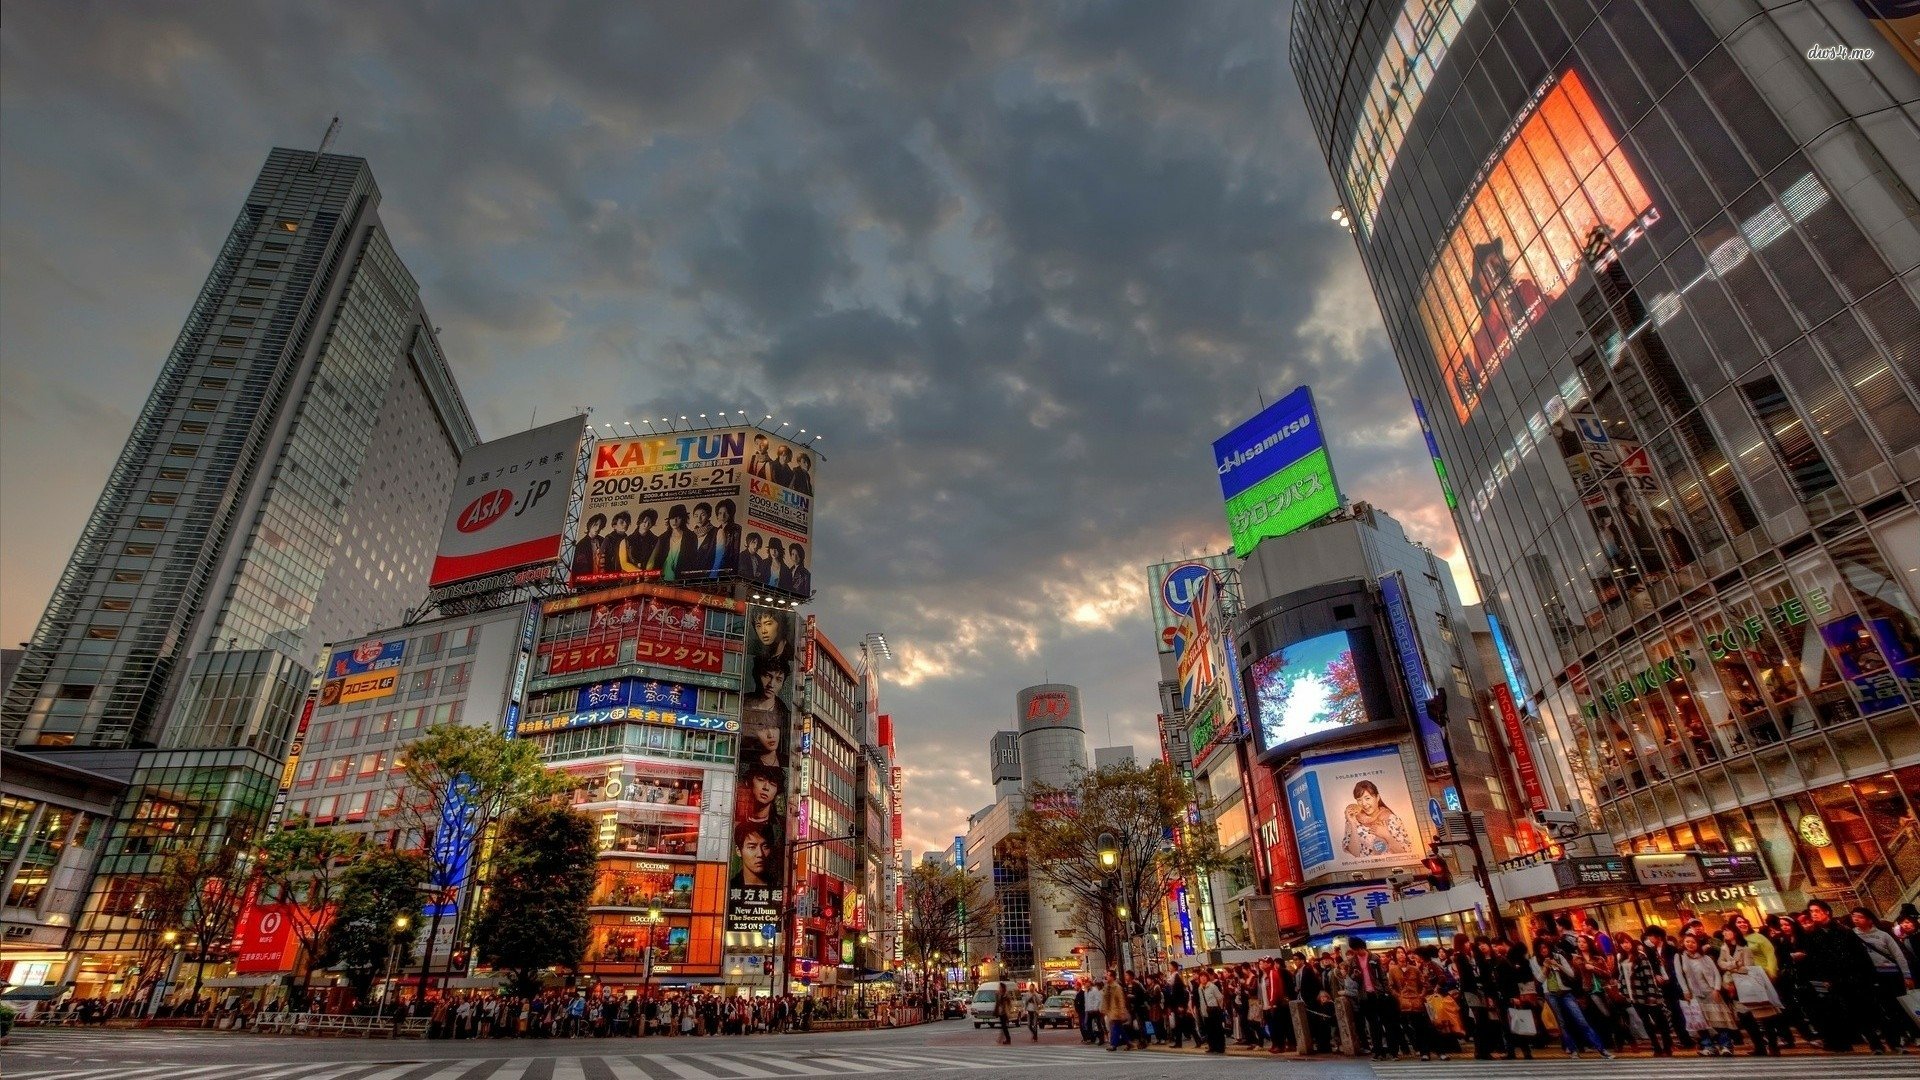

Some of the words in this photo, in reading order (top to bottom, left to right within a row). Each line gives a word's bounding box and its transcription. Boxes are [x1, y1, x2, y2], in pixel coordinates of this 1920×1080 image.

[595, 432, 746, 470] KAT-TUN
[1218, 413, 1311, 475] Hisamitsu
[467, 452, 564, 486] 最速ブログ検索
[591, 472, 692, 496] 2009.5.15
[750, 478, 809, 510] KAT-TUN
[749, 495, 789, 514] 2009.5.15
[1233, 472, 1324, 533] サロンパス
[516, 565, 551, 585] group
[553, 644, 617, 669] プライス
[637, 641, 719, 666] コンタクト
[343, 679, 379, 696] プロミス
[381, 678, 393, 687] 4F
[518, 714, 569, 733] 英会話&留学
[569, 711, 610, 724] イーオン
[611, 710, 623, 719] 6F
[628, 707, 677, 724] 英会話
[677, 715, 724, 729] イーオン
[726, 721, 738, 730] 6F
[636, 862, 669, 870] L'OCCITANE
[730, 888, 783, 902] 東方神起
[735, 907, 751, 915] New
[752, 906, 777, 915] Album
